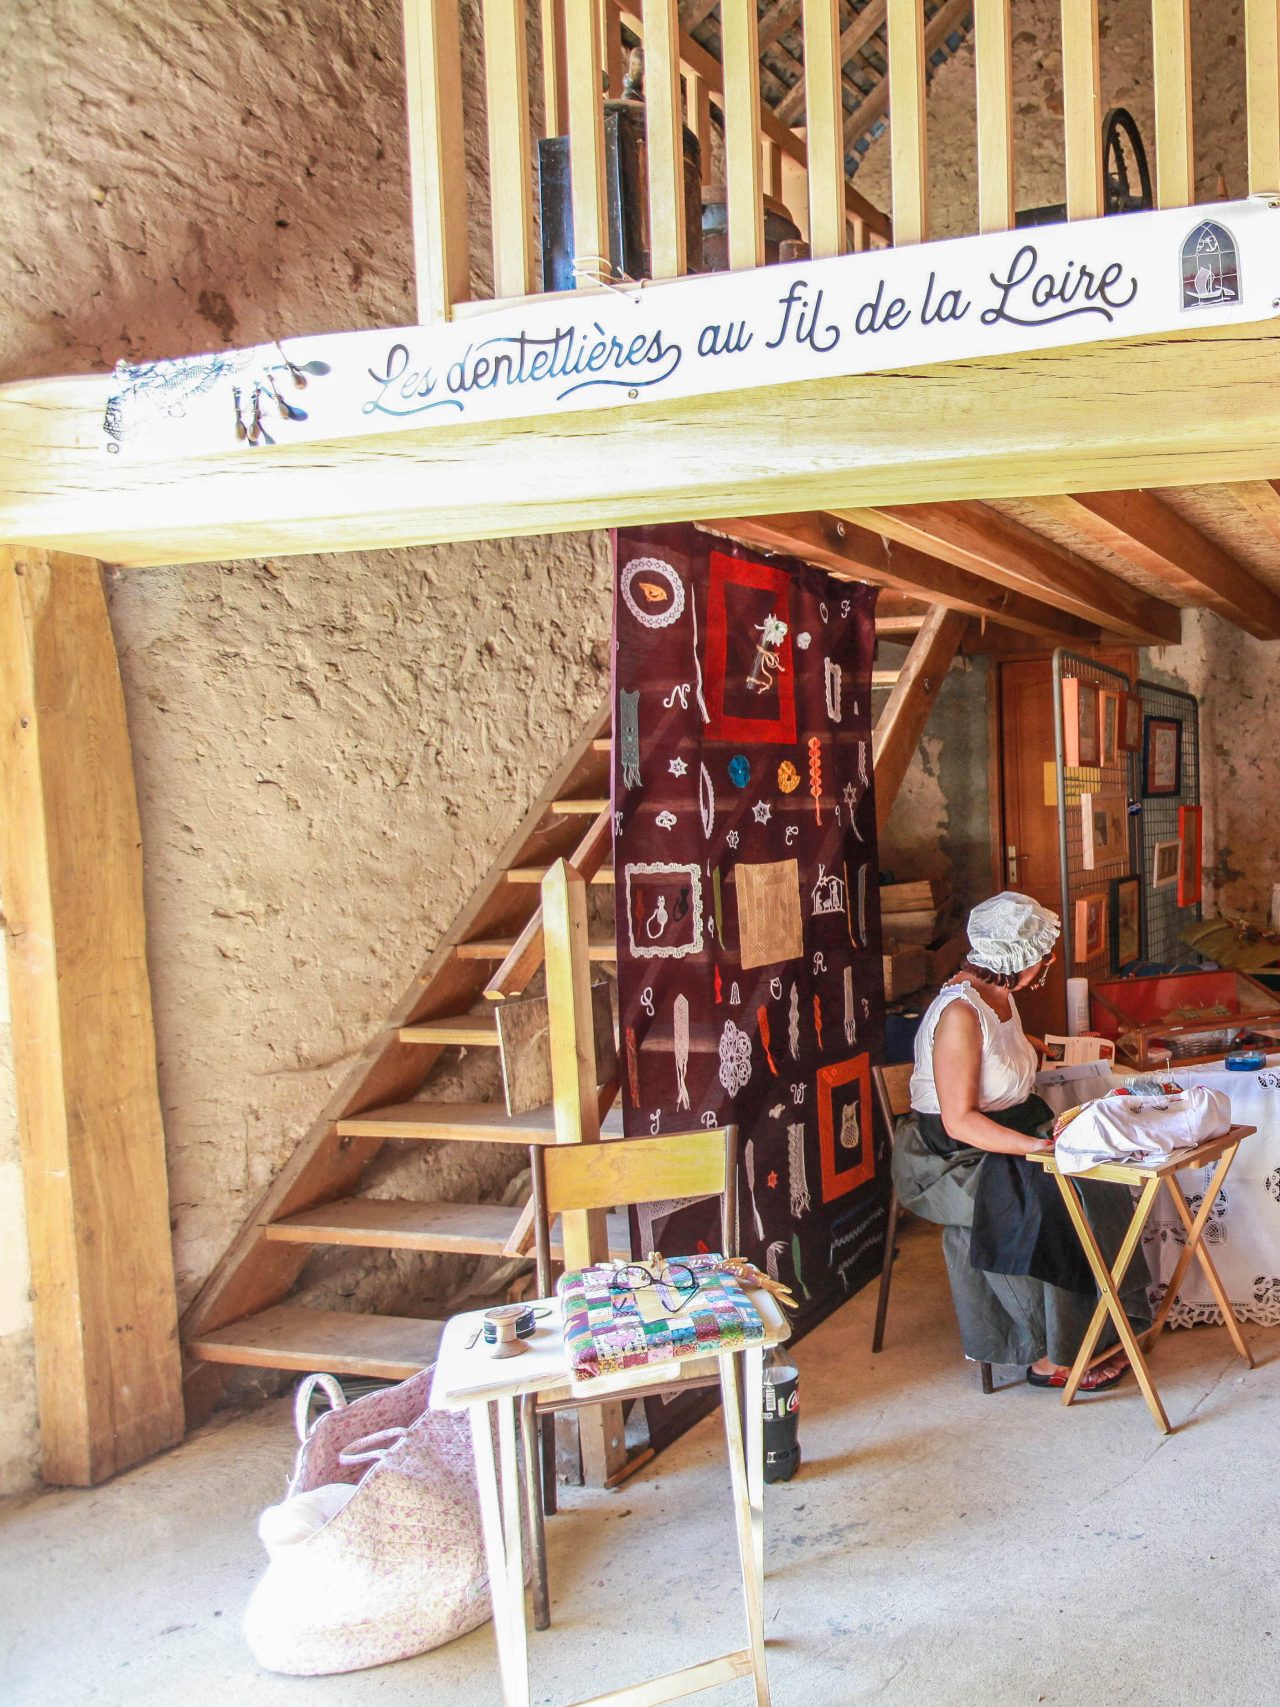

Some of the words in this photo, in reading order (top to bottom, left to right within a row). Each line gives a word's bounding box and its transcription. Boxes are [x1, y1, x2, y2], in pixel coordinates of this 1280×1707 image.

[362, 343, 464, 416] Les
[446, 321, 682, 400] dentellières
[697, 318, 754, 358] au
[764, 280, 840, 353] fil
[855, 280, 912, 335] de
[921, 272, 971, 325] la
[981, 245, 1137, 327] Loire
